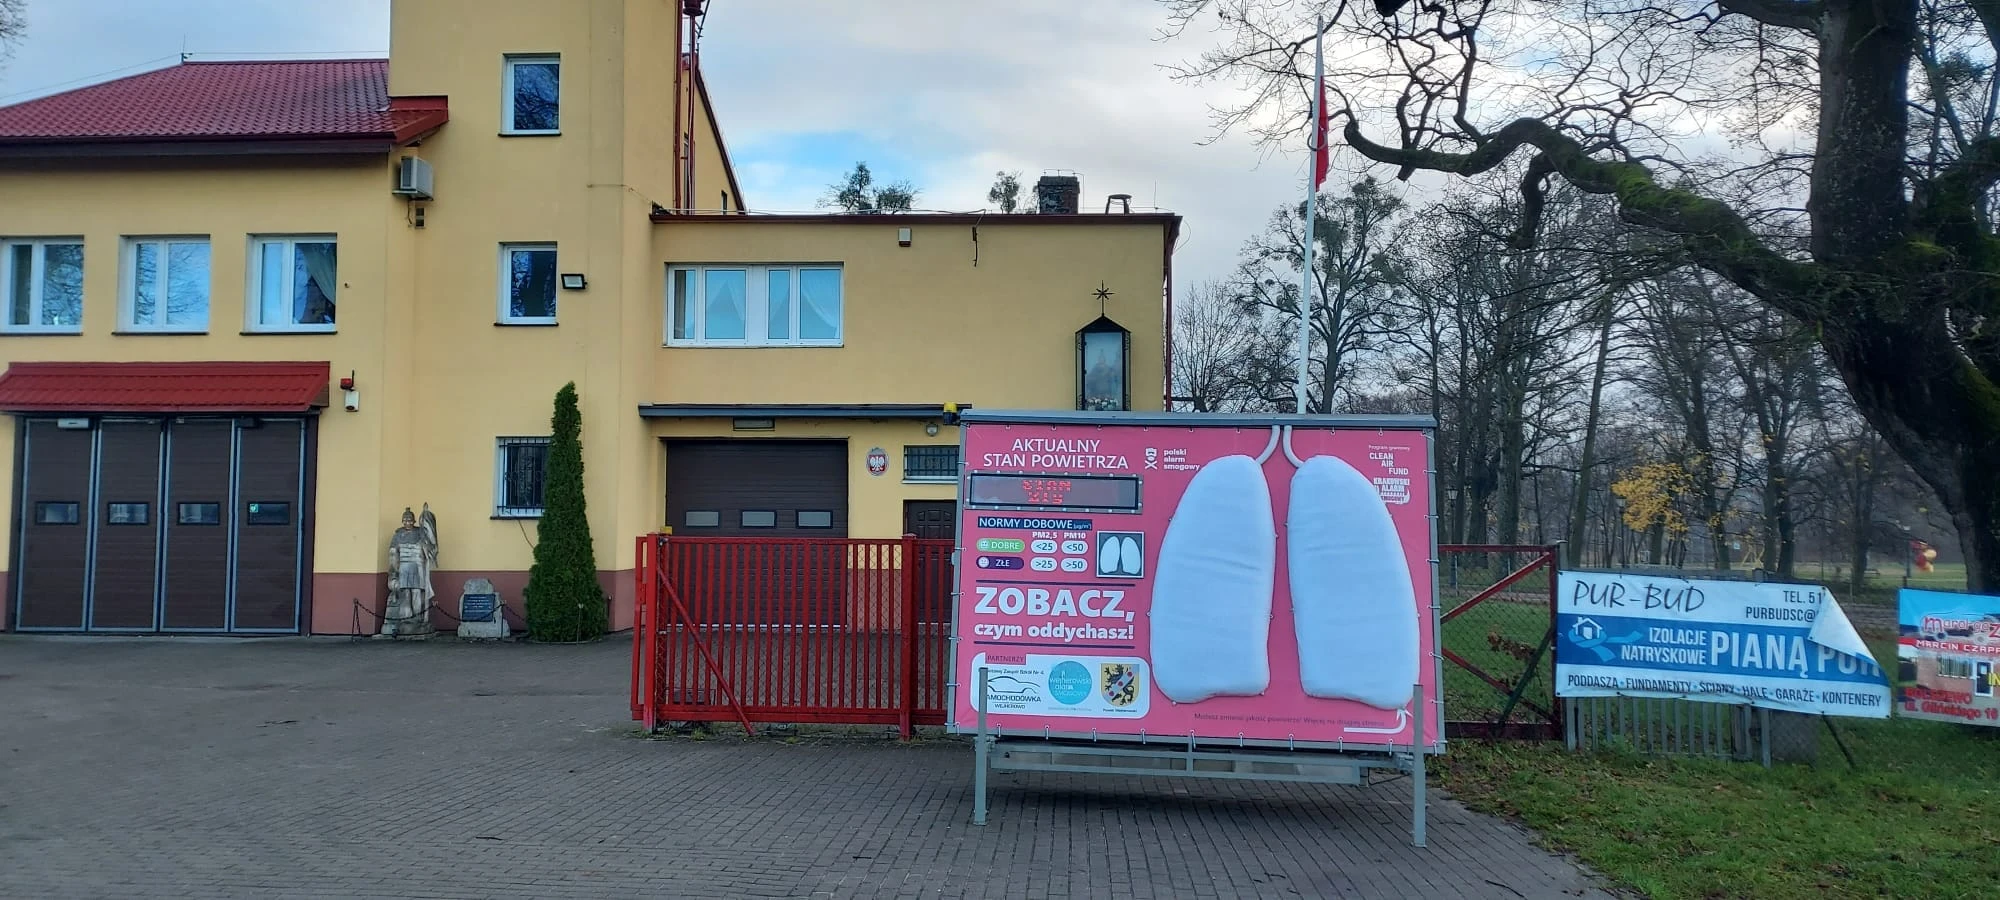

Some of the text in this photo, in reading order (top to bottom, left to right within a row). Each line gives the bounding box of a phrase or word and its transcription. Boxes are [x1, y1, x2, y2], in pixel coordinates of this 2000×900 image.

[1012, 438, 1101, 453] AKTUALNY
[1163, 448, 1187, 456] polski
[983, 453, 1129, 470] STAN POWIETRZA
[1388, 467, 1409, 475] FUND
[979, 517, 1021, 529] NORMY
[1024, 519, 1073, 529] DOBOWE
[1032, 531, 1058, 539] PM2,5
[1063, 532, 1086, 540] PM10
[991, 540, 1020, 550] DOBRE
[1036, 542, 1053, 551] <25
[1066, 543, 1084, 552] <50
[995, 558, 1010, 567] ZŁE
[1036, 560, 1053, 569] >25
[1066, 561, 1084, 570] >50
[1572, 580, 1705, 612] PUR-BUD
[1783, 590, 1806, 604] TEL.
[975, 587, 1135, 622] ZOBACZ,
[1745, 606, 1816, 623] PURBUDSC@
[974, 622, 1135, 642] czym oddychasz!
[1649, 627, 1706, 646] IZOLACJE
[1916, 639, 1959, 651] MARCIN
[987, 655, 1025, 663] PARTNERZY
[1620, 645, 1706, 666] NATRYSKOWE
[1711, 631, 1809, 678] PIANĄ
[1568, 674, 1882, 707] PODDASZA FUNDAMENTY ŚCIANY HALE GARAŻE KONTENERY
